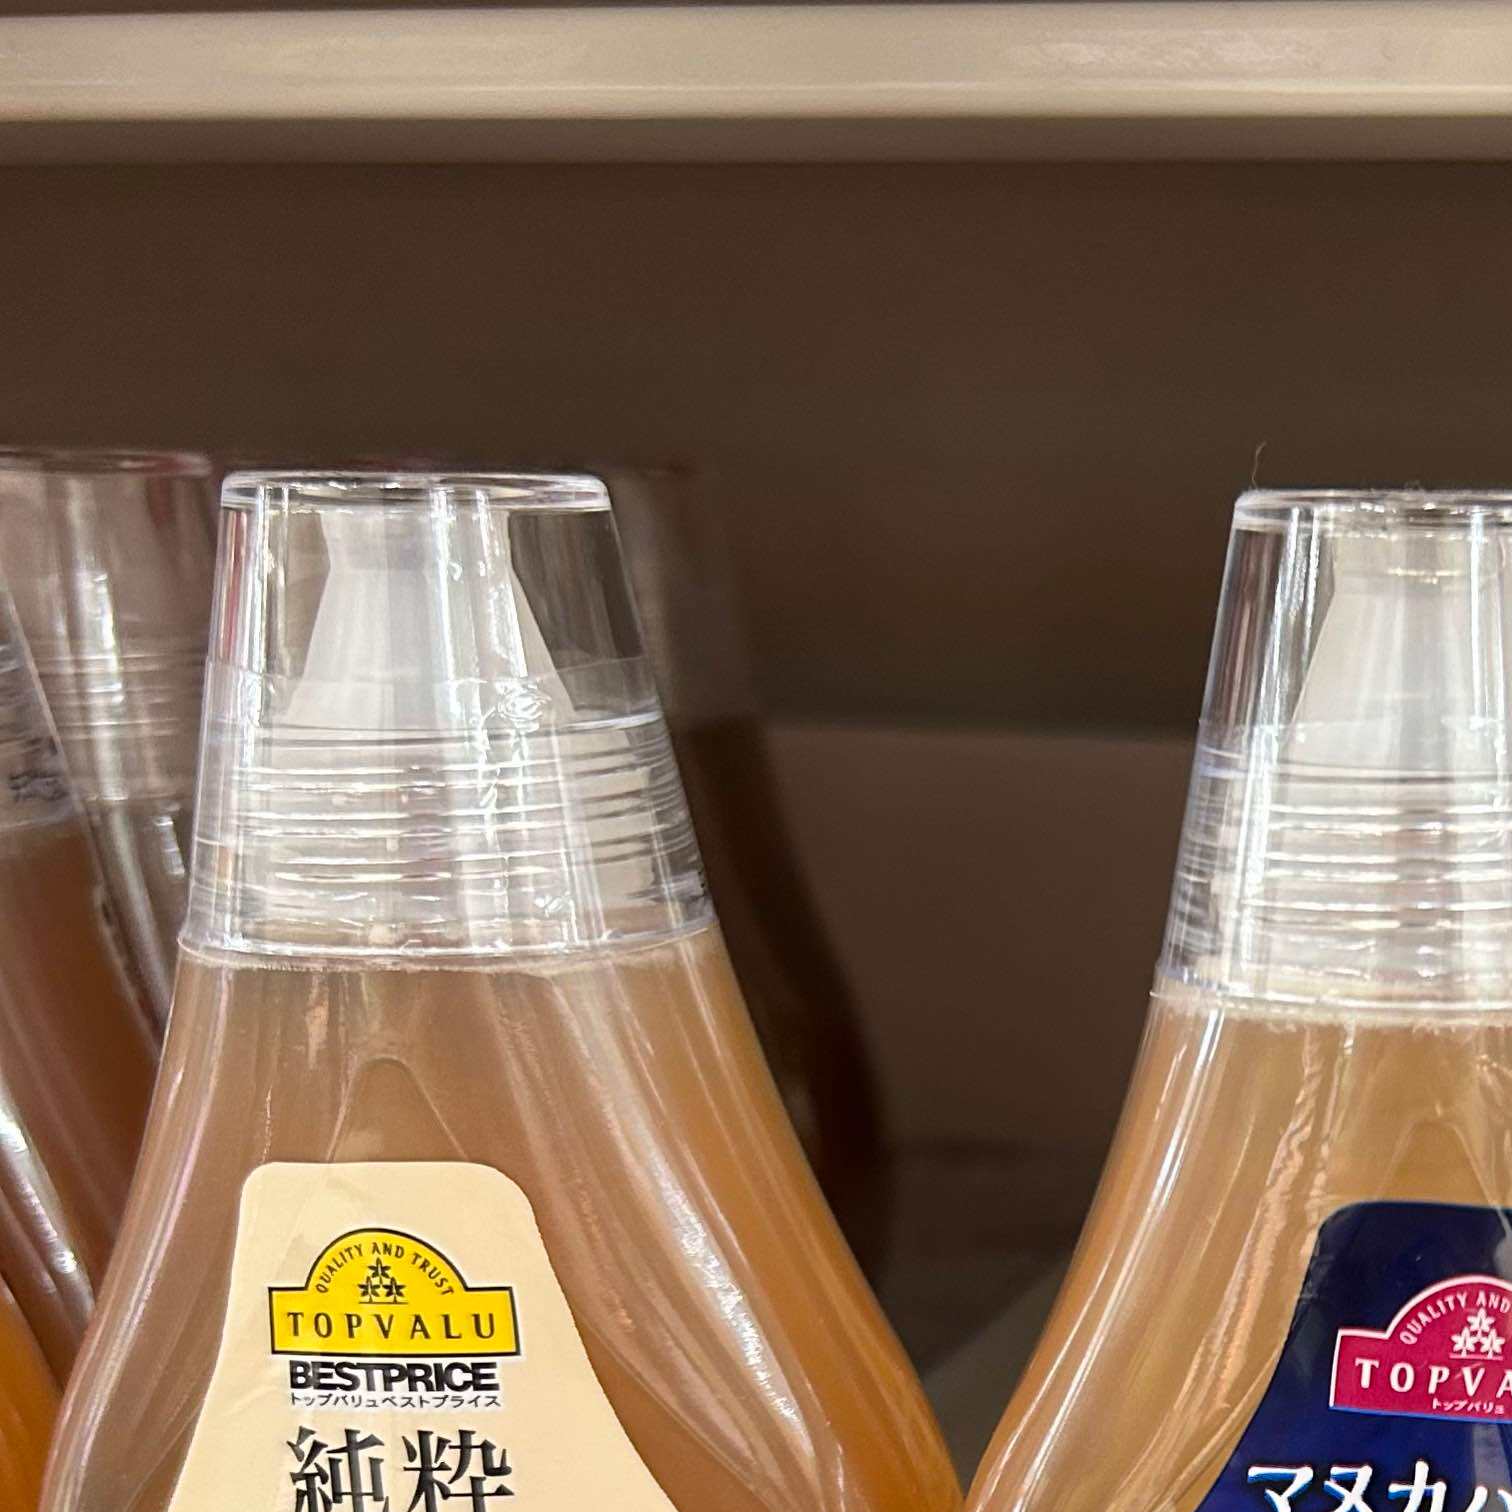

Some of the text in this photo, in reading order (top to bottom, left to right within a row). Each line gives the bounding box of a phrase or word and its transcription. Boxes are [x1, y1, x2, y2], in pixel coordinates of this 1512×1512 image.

[315, 1241, 455, 1296] QUALITY AND TRUST
[286, 1311, 495, 1340] TOPVALU
[1400, 1291, 1466, 1346] QUALITY
[1476, 1291, 1511, 1314] AND
[289, 1359, 500, 1392] BESTPRICE
[290, 1393, 502, 1410] トップバリュベストプライス
[1431, 1396, 1504, 1415] トップバリュ
